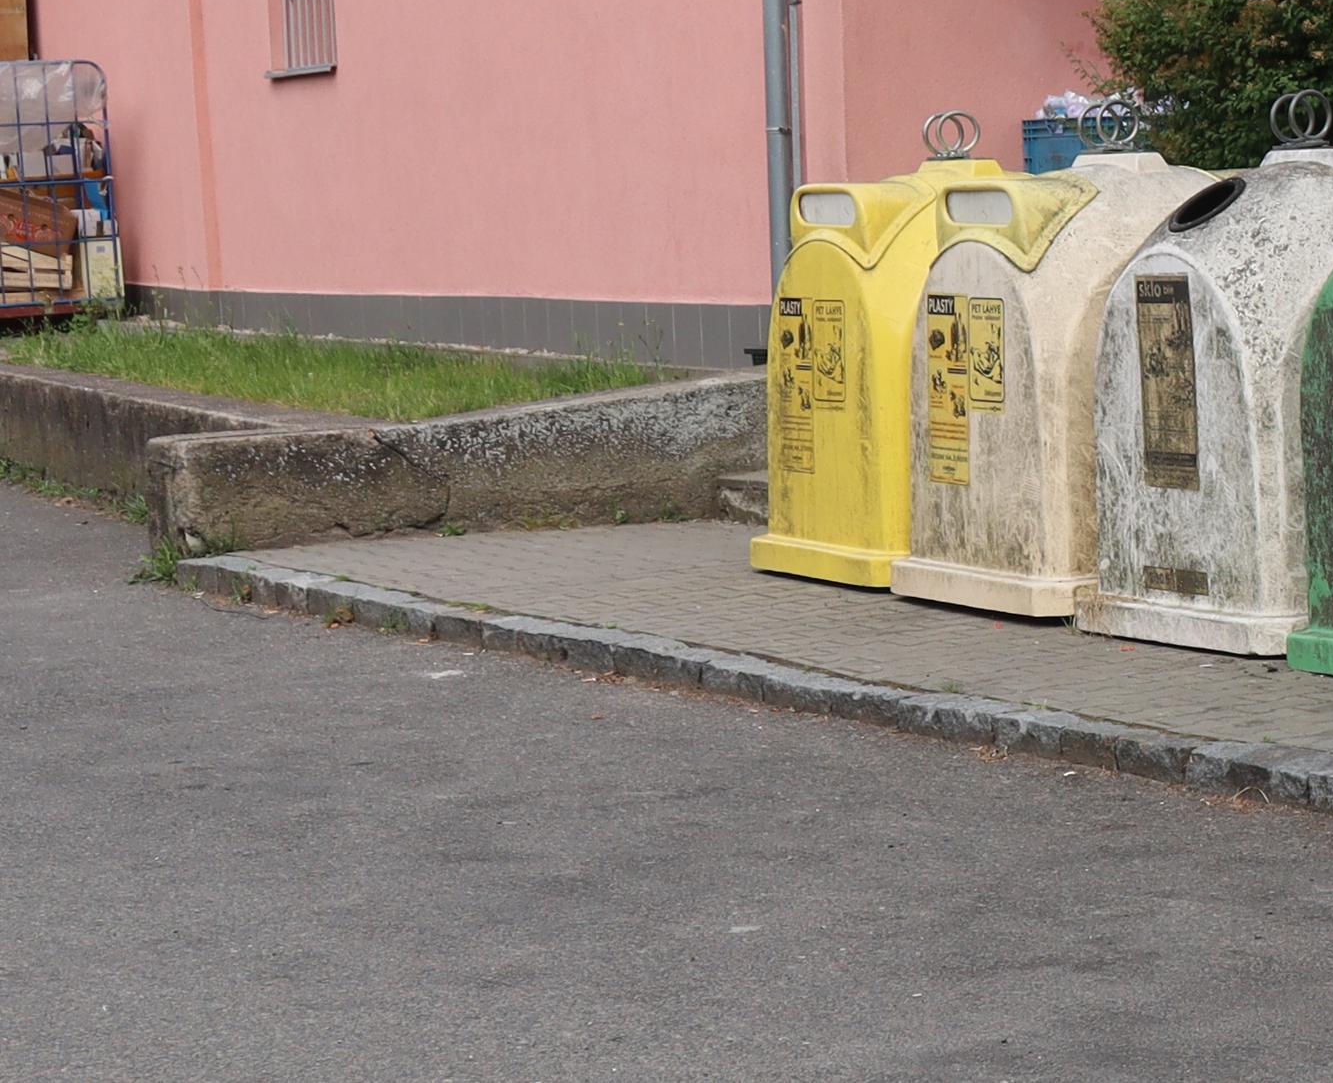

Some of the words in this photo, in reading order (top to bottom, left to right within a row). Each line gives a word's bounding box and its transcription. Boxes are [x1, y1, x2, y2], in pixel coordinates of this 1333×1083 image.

[1139, 280, 1161, 297] sklo
[780, 300, 800, 314] PLASTY
[928, 298, 953, 313] PLASTY
